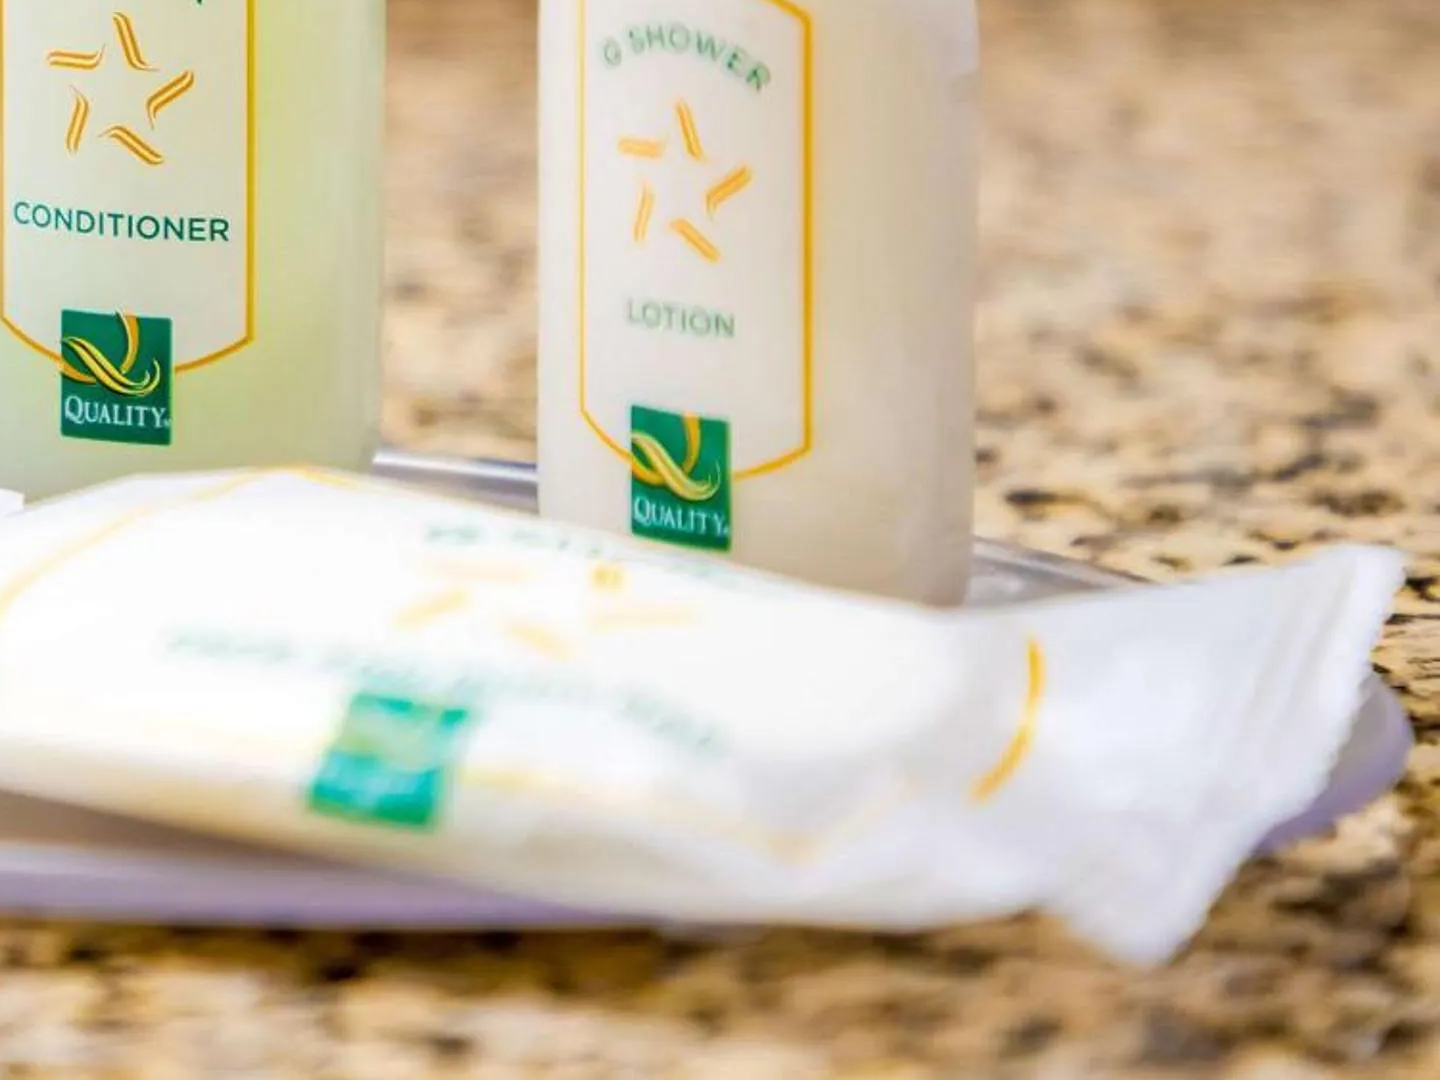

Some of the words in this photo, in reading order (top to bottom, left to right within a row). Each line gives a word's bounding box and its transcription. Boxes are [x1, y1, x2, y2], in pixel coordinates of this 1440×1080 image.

[628, 22, 773, 91] SHOWER
[13, 200, 231, 242] CONDITIONER
[625, 296, 737, 339] LOTION
[64, 395, 167, 428] QUALITY
[633, 495, 726, 537] QUALITY
